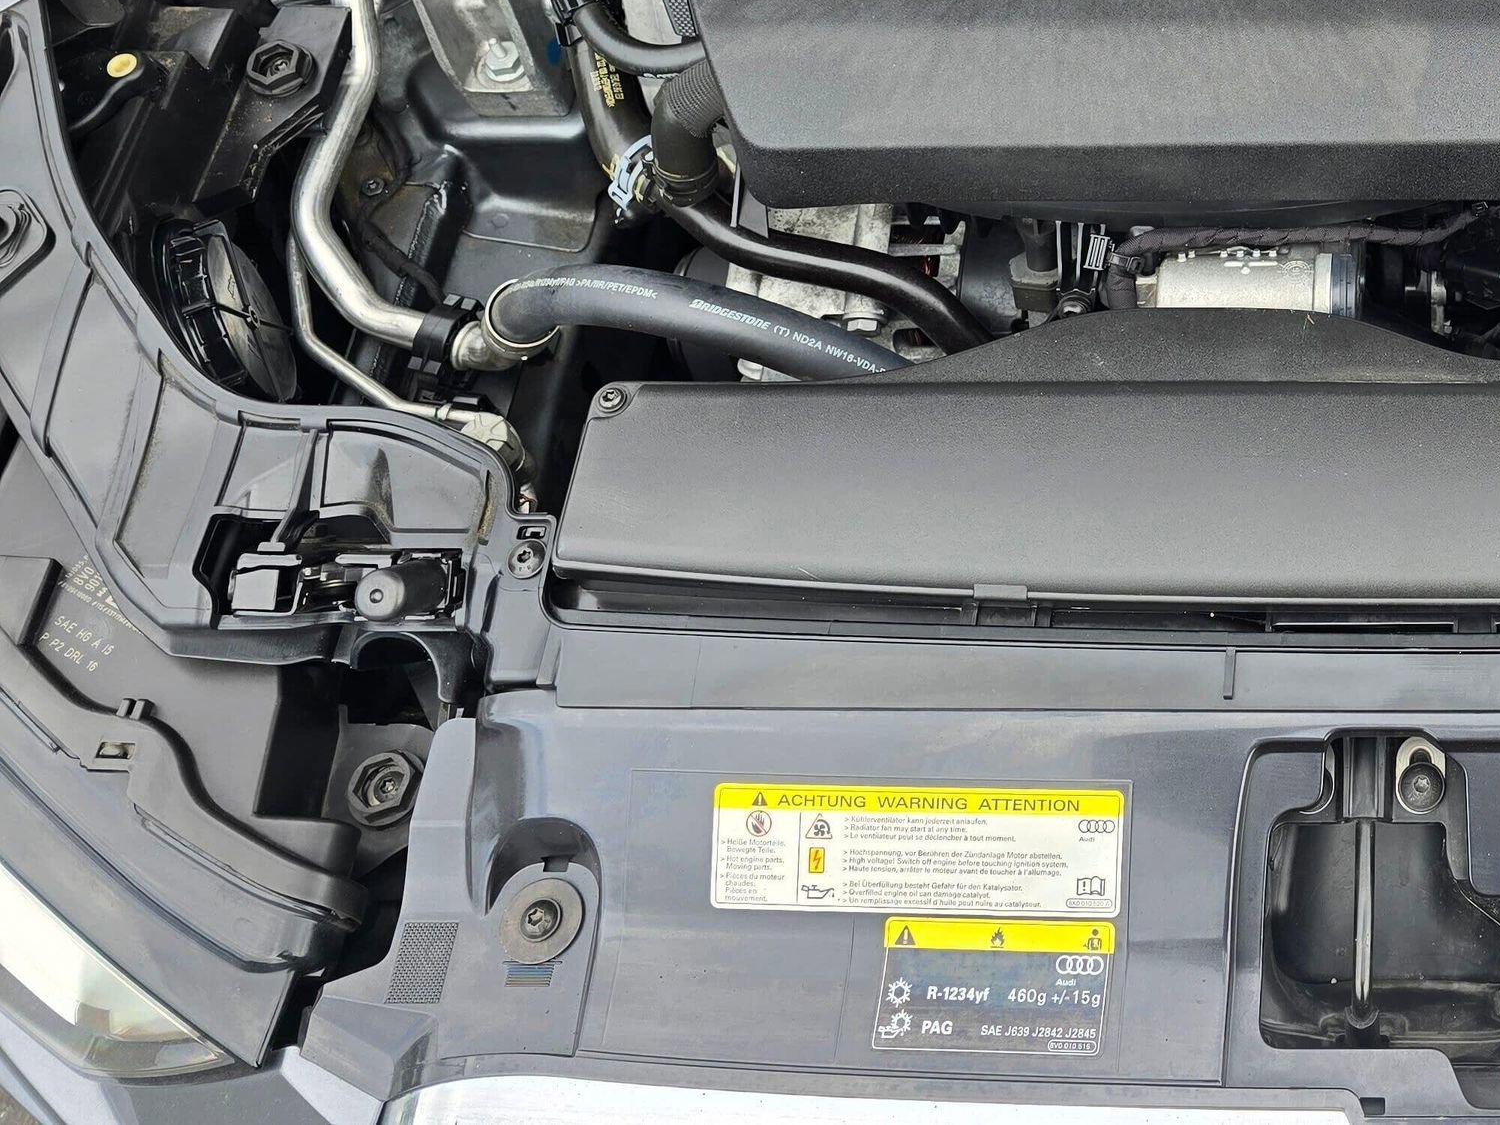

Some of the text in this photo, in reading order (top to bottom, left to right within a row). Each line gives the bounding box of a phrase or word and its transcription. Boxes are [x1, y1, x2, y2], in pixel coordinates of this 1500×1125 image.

[689, 298, 771, 330] BRIDGESTONE
[773, 325, 790, 338] (T)
[793, 331, 823, 351] ND2A
[54, 615, 78, 634] SAE
[91, 638, 103, 649] A
[101, 643, 115, 656] 15
[39, 632, 99, 672] P P2 DRL 16
[777, 793, 1080, 813] ACHTUNG WARNING ATTENTION
[907, 816, 924, 824] kann
[925, 817, 955, 825] jederzeit
[956, 818, 987, 826] anlaufen.
[950, 826, 968, 834] time.
[964, 851, 1005, 860] Zündanlage
[1029, 852, 1063, 860] abstellen.
[849, 857, 866, 865] High
[867, 857, 895, 865] voltage!
[726, 862, 752, 871] Moving
[849, 865, 870, 873] Haute
[870, 866, 898, 874] tension,
[931, 882, 955, 890] Gefahr
[956, 882, 968, 890] für
[983, 884, 1023, 893] Katalysator.
[933, 891, 961, 899] damage
[860, 897, 902, 906] remplissage
[1004, 900, 1041, 908] catalyseur.
[1055, 978, 1077, 986] Audi
[926, 986, 990, 1004] R-1234yf
[1007, 988, 1047, 1006] 460g
[921, 1020, 1096, 1039] PAG SAE J639 J2842 J2845
